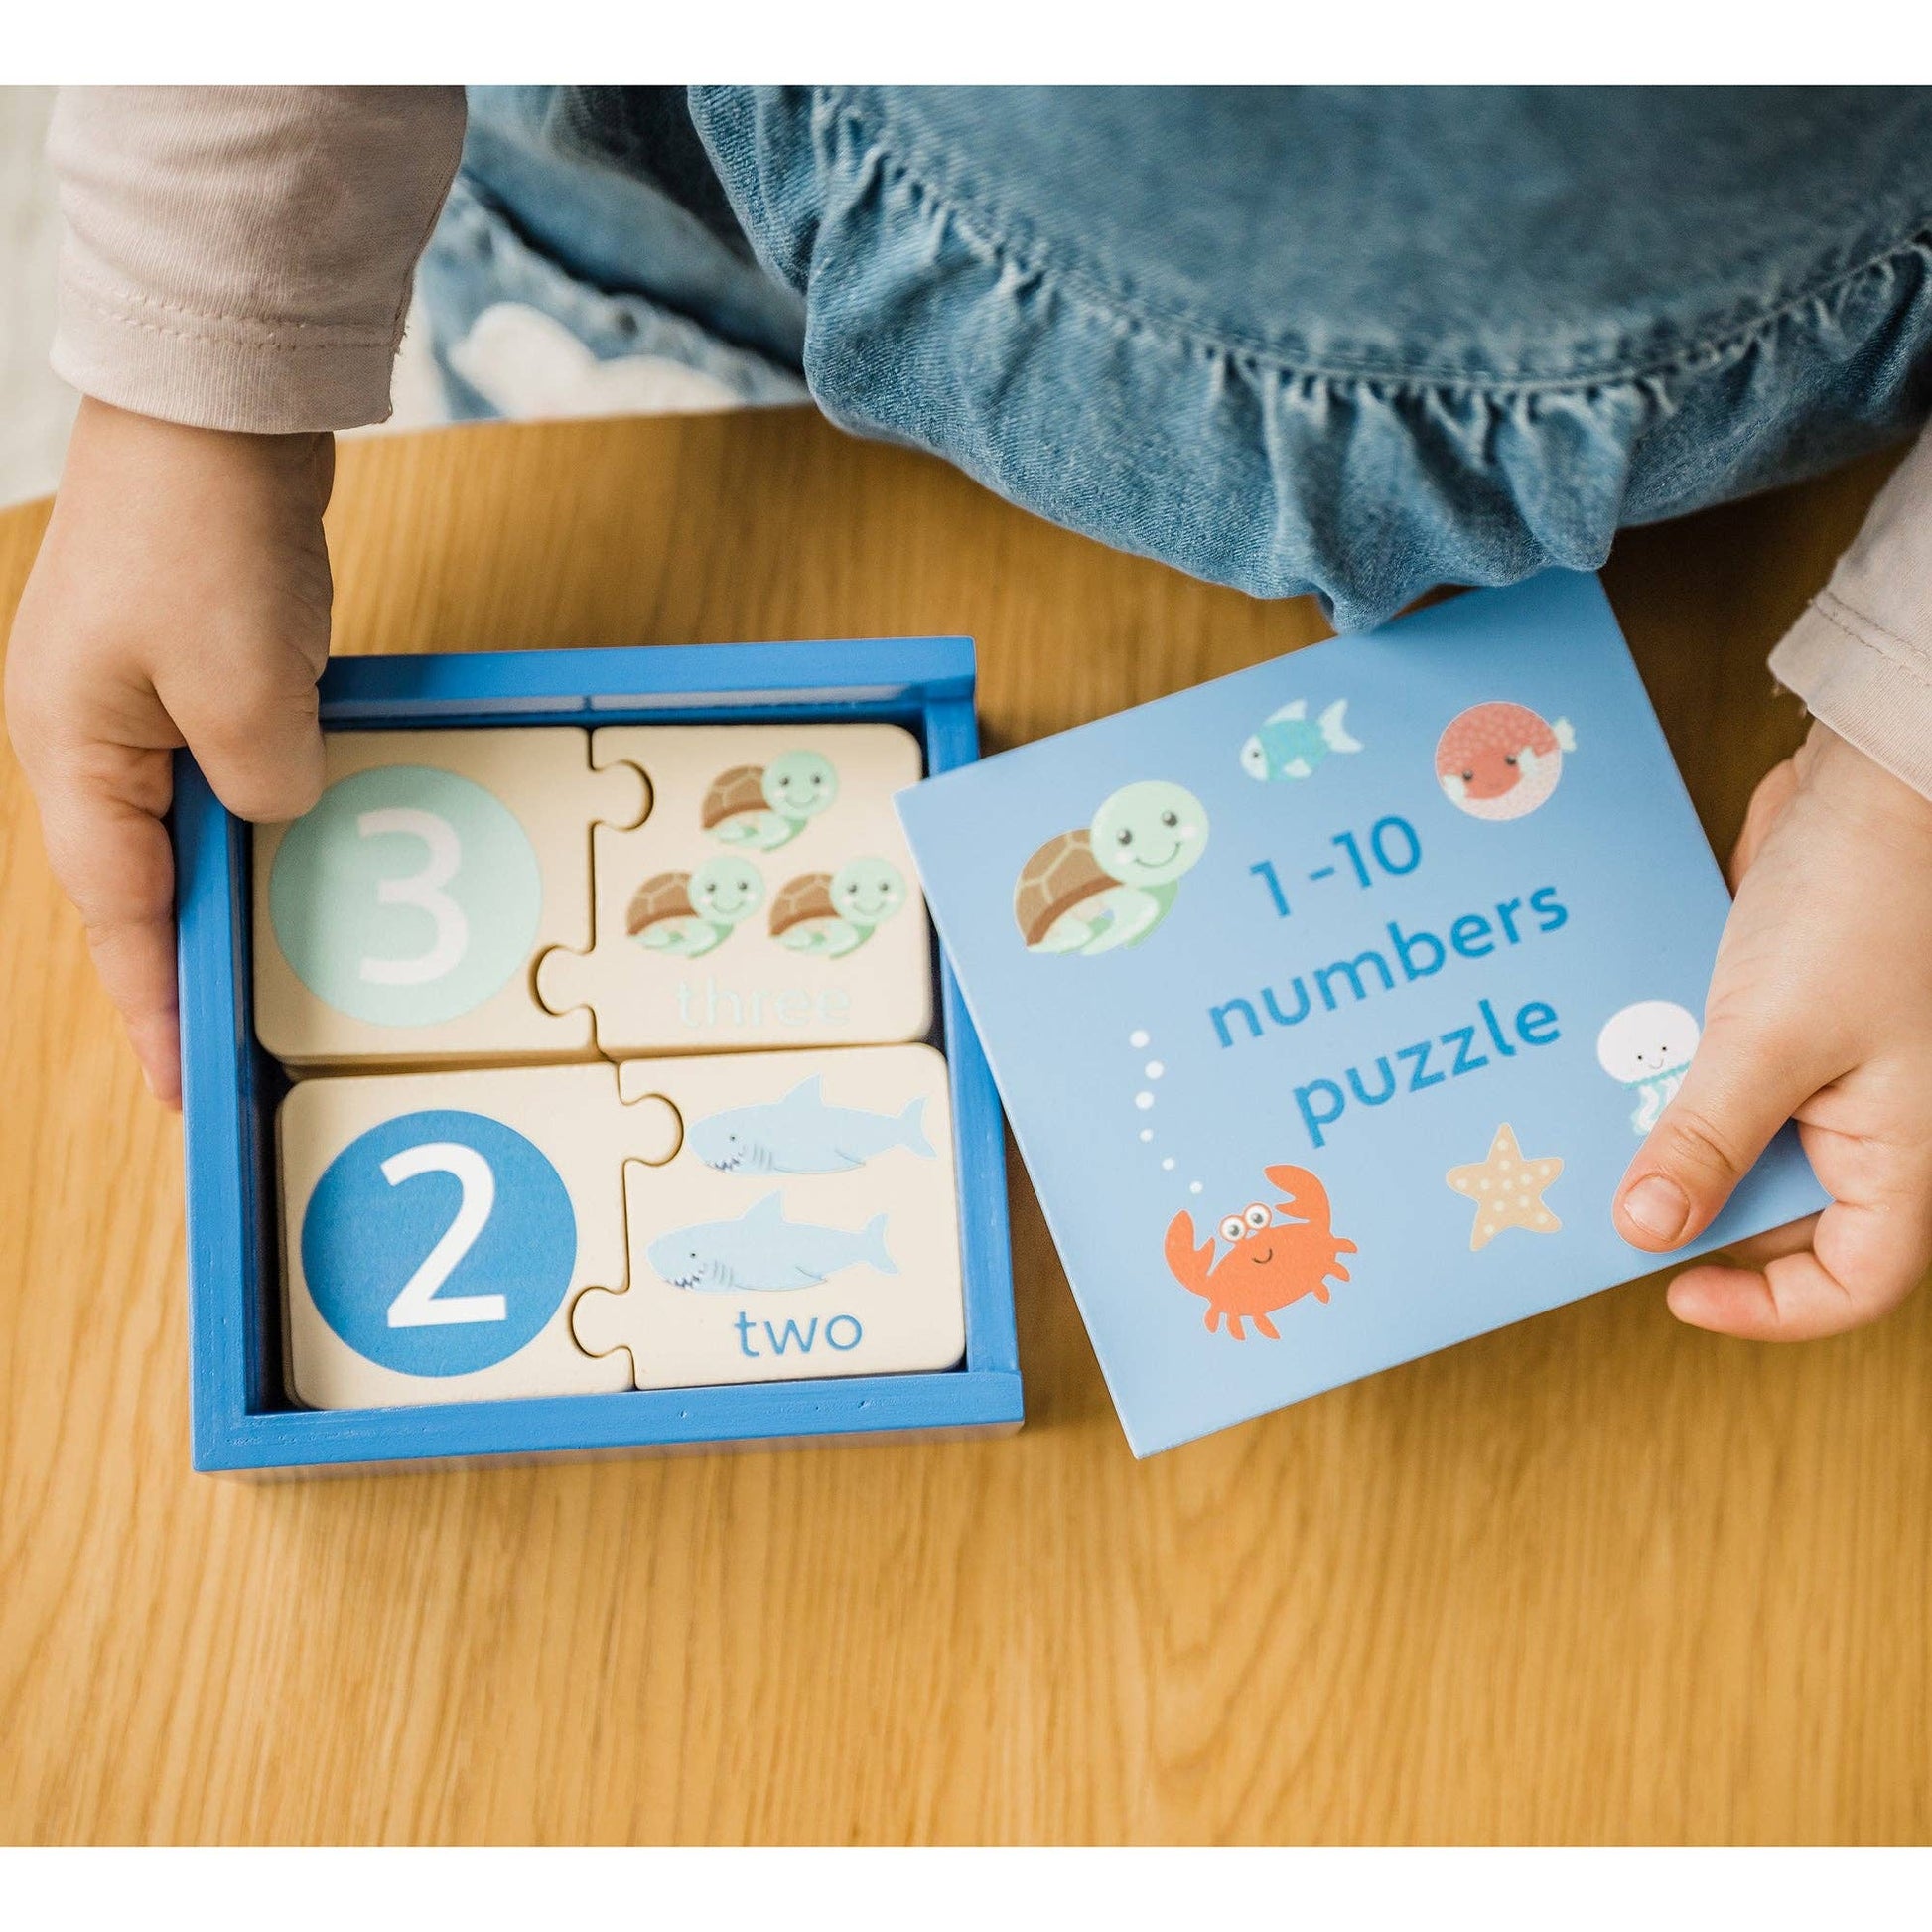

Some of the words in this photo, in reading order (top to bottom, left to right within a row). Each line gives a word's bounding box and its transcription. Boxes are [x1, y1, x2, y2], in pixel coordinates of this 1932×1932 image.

[356, 807, 470, 987] 3
[1207, 886, 1569, 1048] numbers
[677, 978, 853, 1029] three
[1292, 999, 1563, 1149] puzzle
[379, 1141, 508, 1330] 2
[733, 1307, 865, 1358] two
